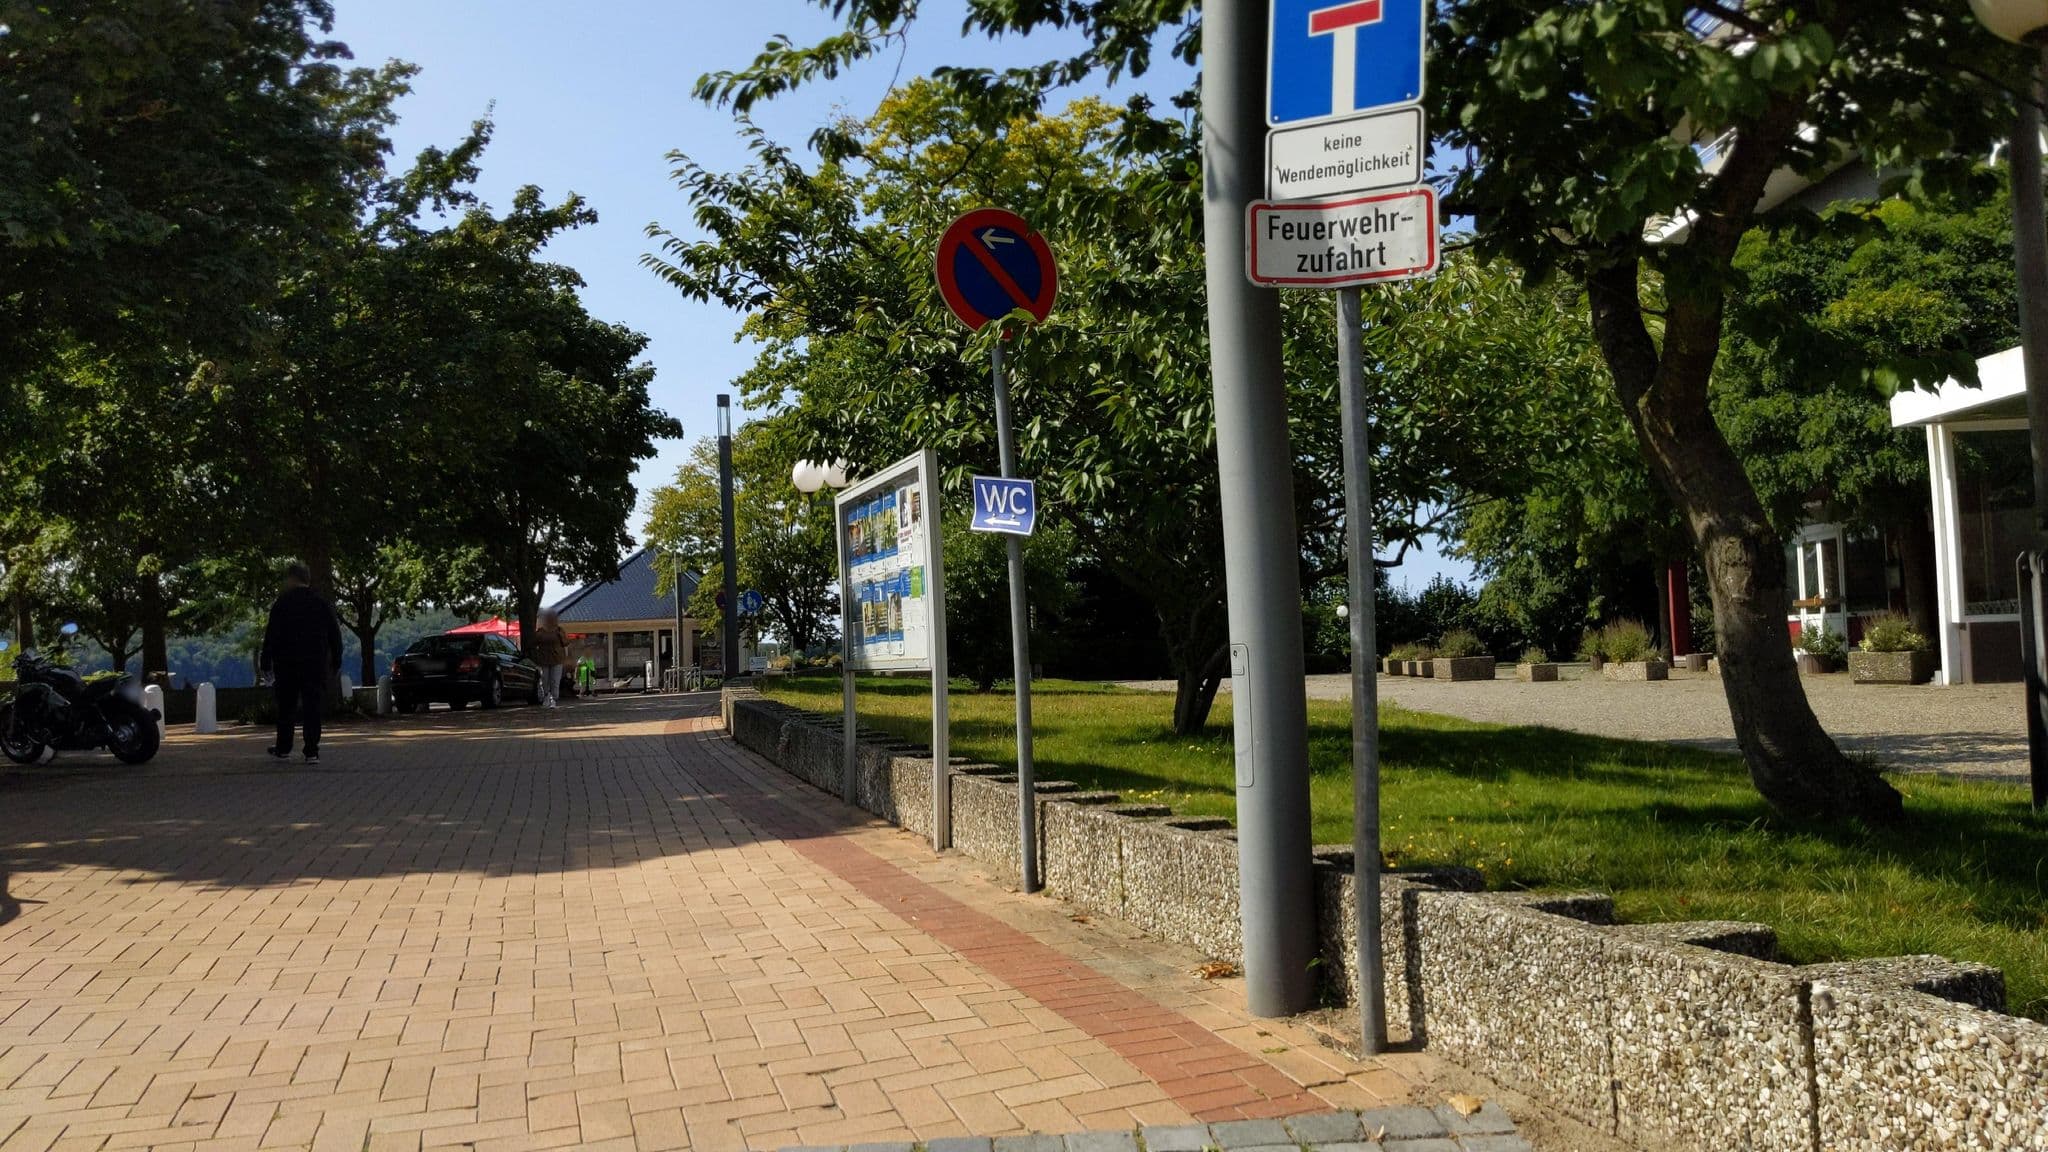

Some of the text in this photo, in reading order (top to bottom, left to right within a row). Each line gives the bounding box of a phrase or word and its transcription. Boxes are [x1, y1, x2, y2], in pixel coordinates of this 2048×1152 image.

[1323, 134, 1362, 151] keine
[1278, 152, 1410, 184] Wendemöglichkeit
[1268, 207, 1413, 240] Feuerwehr-
[1297, 242, 1386, 272] zufahrt
[980, 483, 1027, 514] WC
